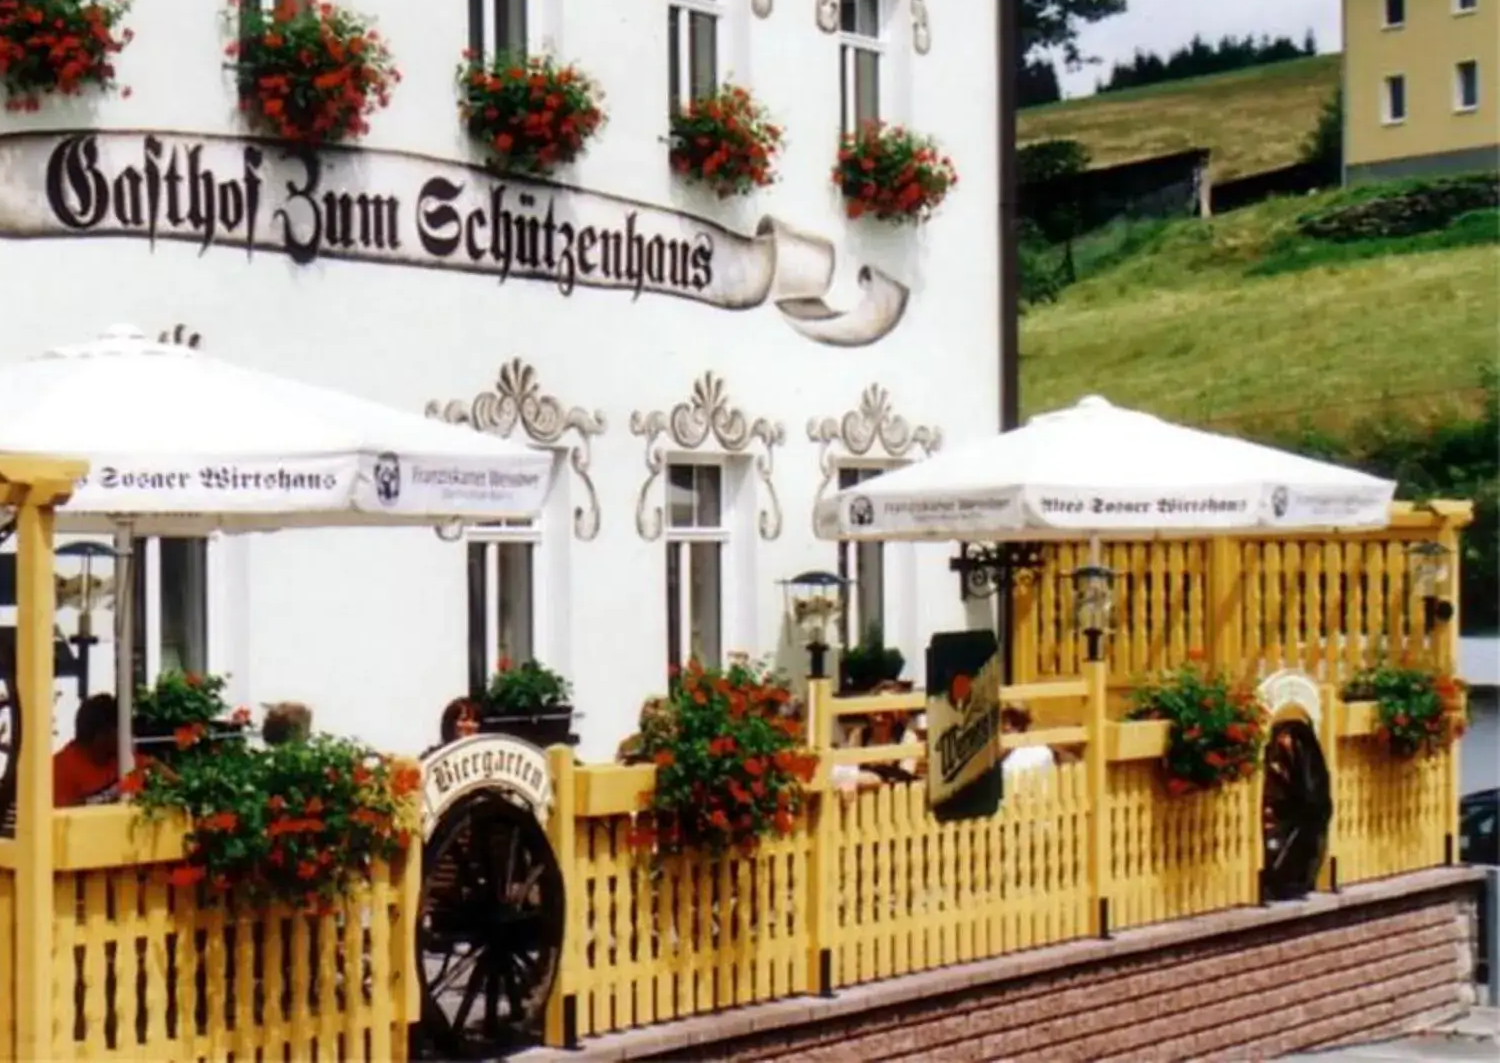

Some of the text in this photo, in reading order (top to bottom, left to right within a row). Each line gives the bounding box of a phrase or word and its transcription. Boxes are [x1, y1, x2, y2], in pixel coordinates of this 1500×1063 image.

[416, 175, 715, 298] Schützenhaus
[199, 466, 338, 492] Wirtshaus
[432, 748, 544, 793] Biergarten
